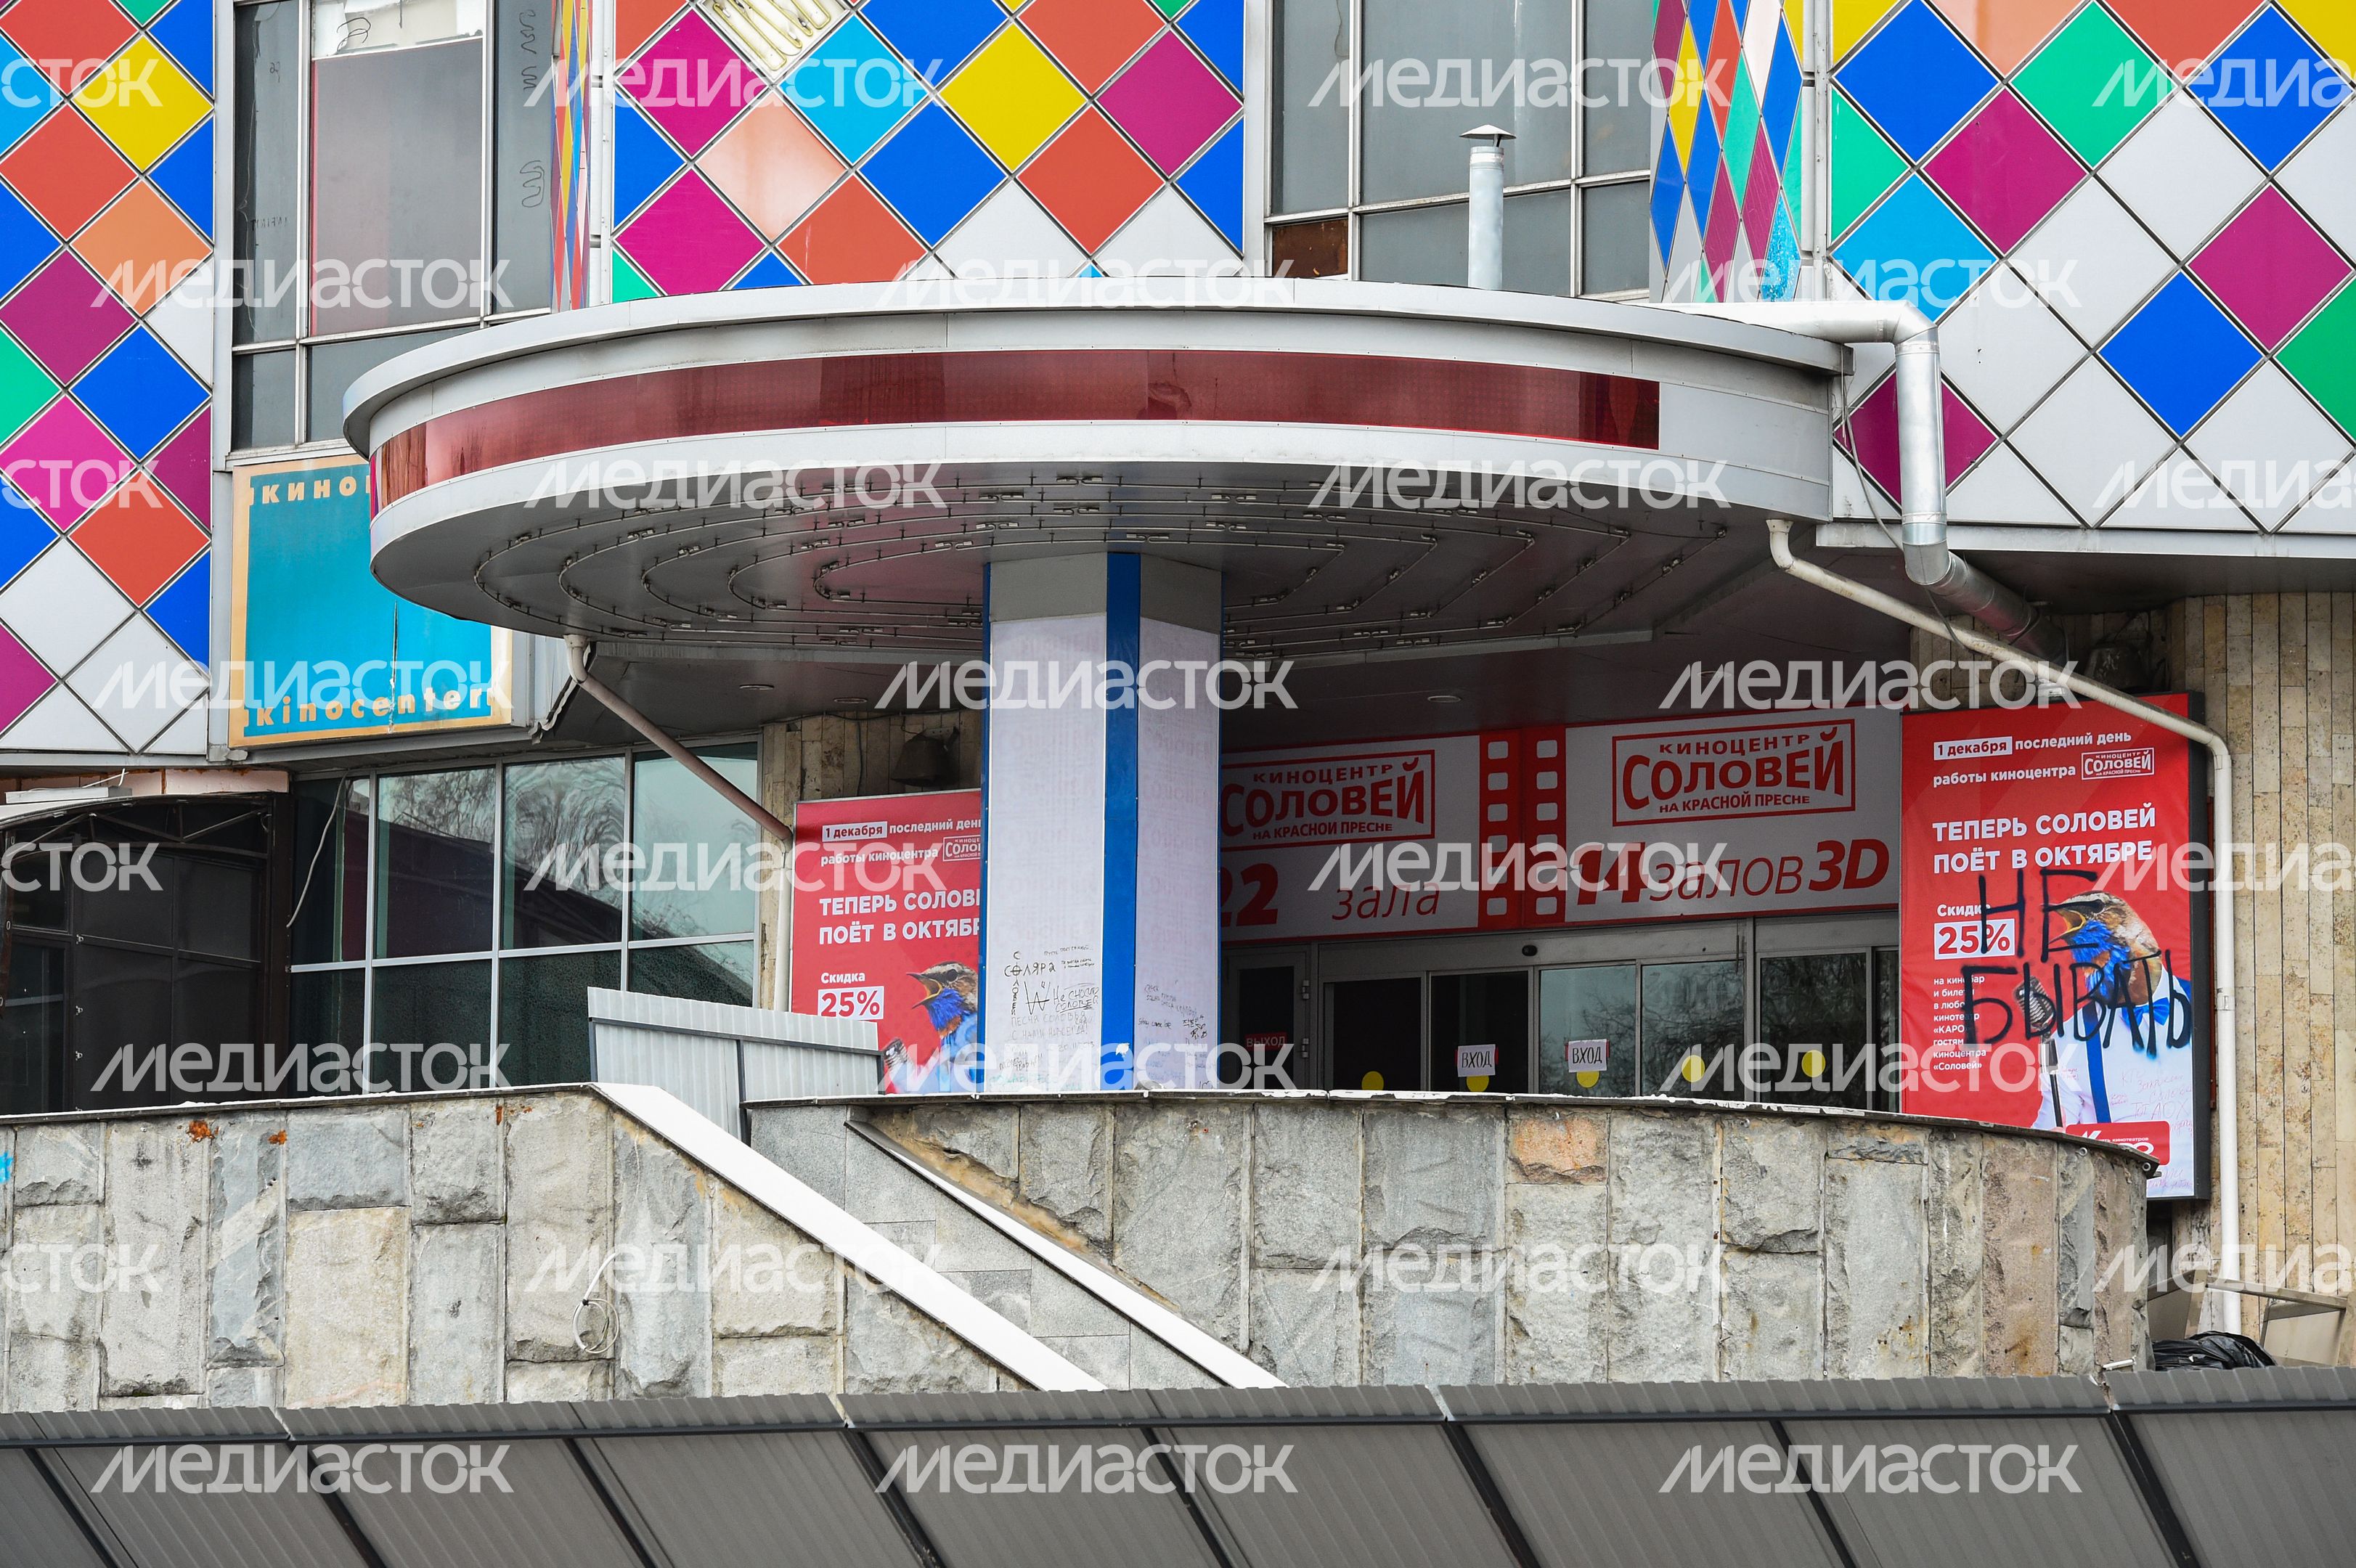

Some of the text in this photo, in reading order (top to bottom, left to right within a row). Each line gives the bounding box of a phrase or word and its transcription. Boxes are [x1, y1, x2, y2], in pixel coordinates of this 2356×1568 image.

[1659, 734, 1810, 756] КИНОЦЕНТР
[1938, 731, 2132, 757] 1 декабря последний день
[1622, 726, 1843, 810] СОЛОВЕЙ
[2084, 750, 2151, 775] СОЛОВЕЙ
[1253, 764, 1393, 785] КИНОЦЕНТР
[1933, 764, 2076, 788] работы киноцентра
[1221, 756, 1424, 837] СОЛОВЕЙ
[1659, 791, 1810, 813] НА КРАСНОЙ ПРЕСНЕ
[825, 828, 831, 838] 1
[833, 825, 883, 839] декабря
[889, 819, 953, 834] последний
[1253, 830, 1271, 840] НА
[1341, 821, 1393, 835] ПРЕСНЕ
[1932, 802, 2156, 842] ТЕПЕРЬ СОЛОВЕЙ
[820, 848, 939, 867] работы киноцентра
[1933, 840, 2153, 874] ПОЁТ В ОКТЯБРЕ
[1650, 856, 1804, 902] залов
[1808, 838, 1890, 892] 3D
[819, 894, 897, 916] ТЕПЕРЬ
[1332, 882, 1440, 921] зала
[1937, 904, 1991, 918] Скидк
[1978, 868, 2098, 963] НЕ
[819, 918, 980, 945] ПОЁТ В ОКТЯБР
[1938, 923, 2011, 955] 25%
[820, 972, 865, 984] Скидка
[820, 990, 880, 1018] 25%
[1961, 949, 2193, 1058] БЫВАТЬ
[1933, 1024, 1965, 1034] «КАРО
[1246, 1036, 1286, 1048] ВЫХОД
[1462, 1050, 1493, 1069] ВХОД
[1572, 1047, 1603, 1064] ВХОД
[1933, 1050, 1986, 1058] киноцентра
[1933, 1061, 1983, 1071] «Соловей»
